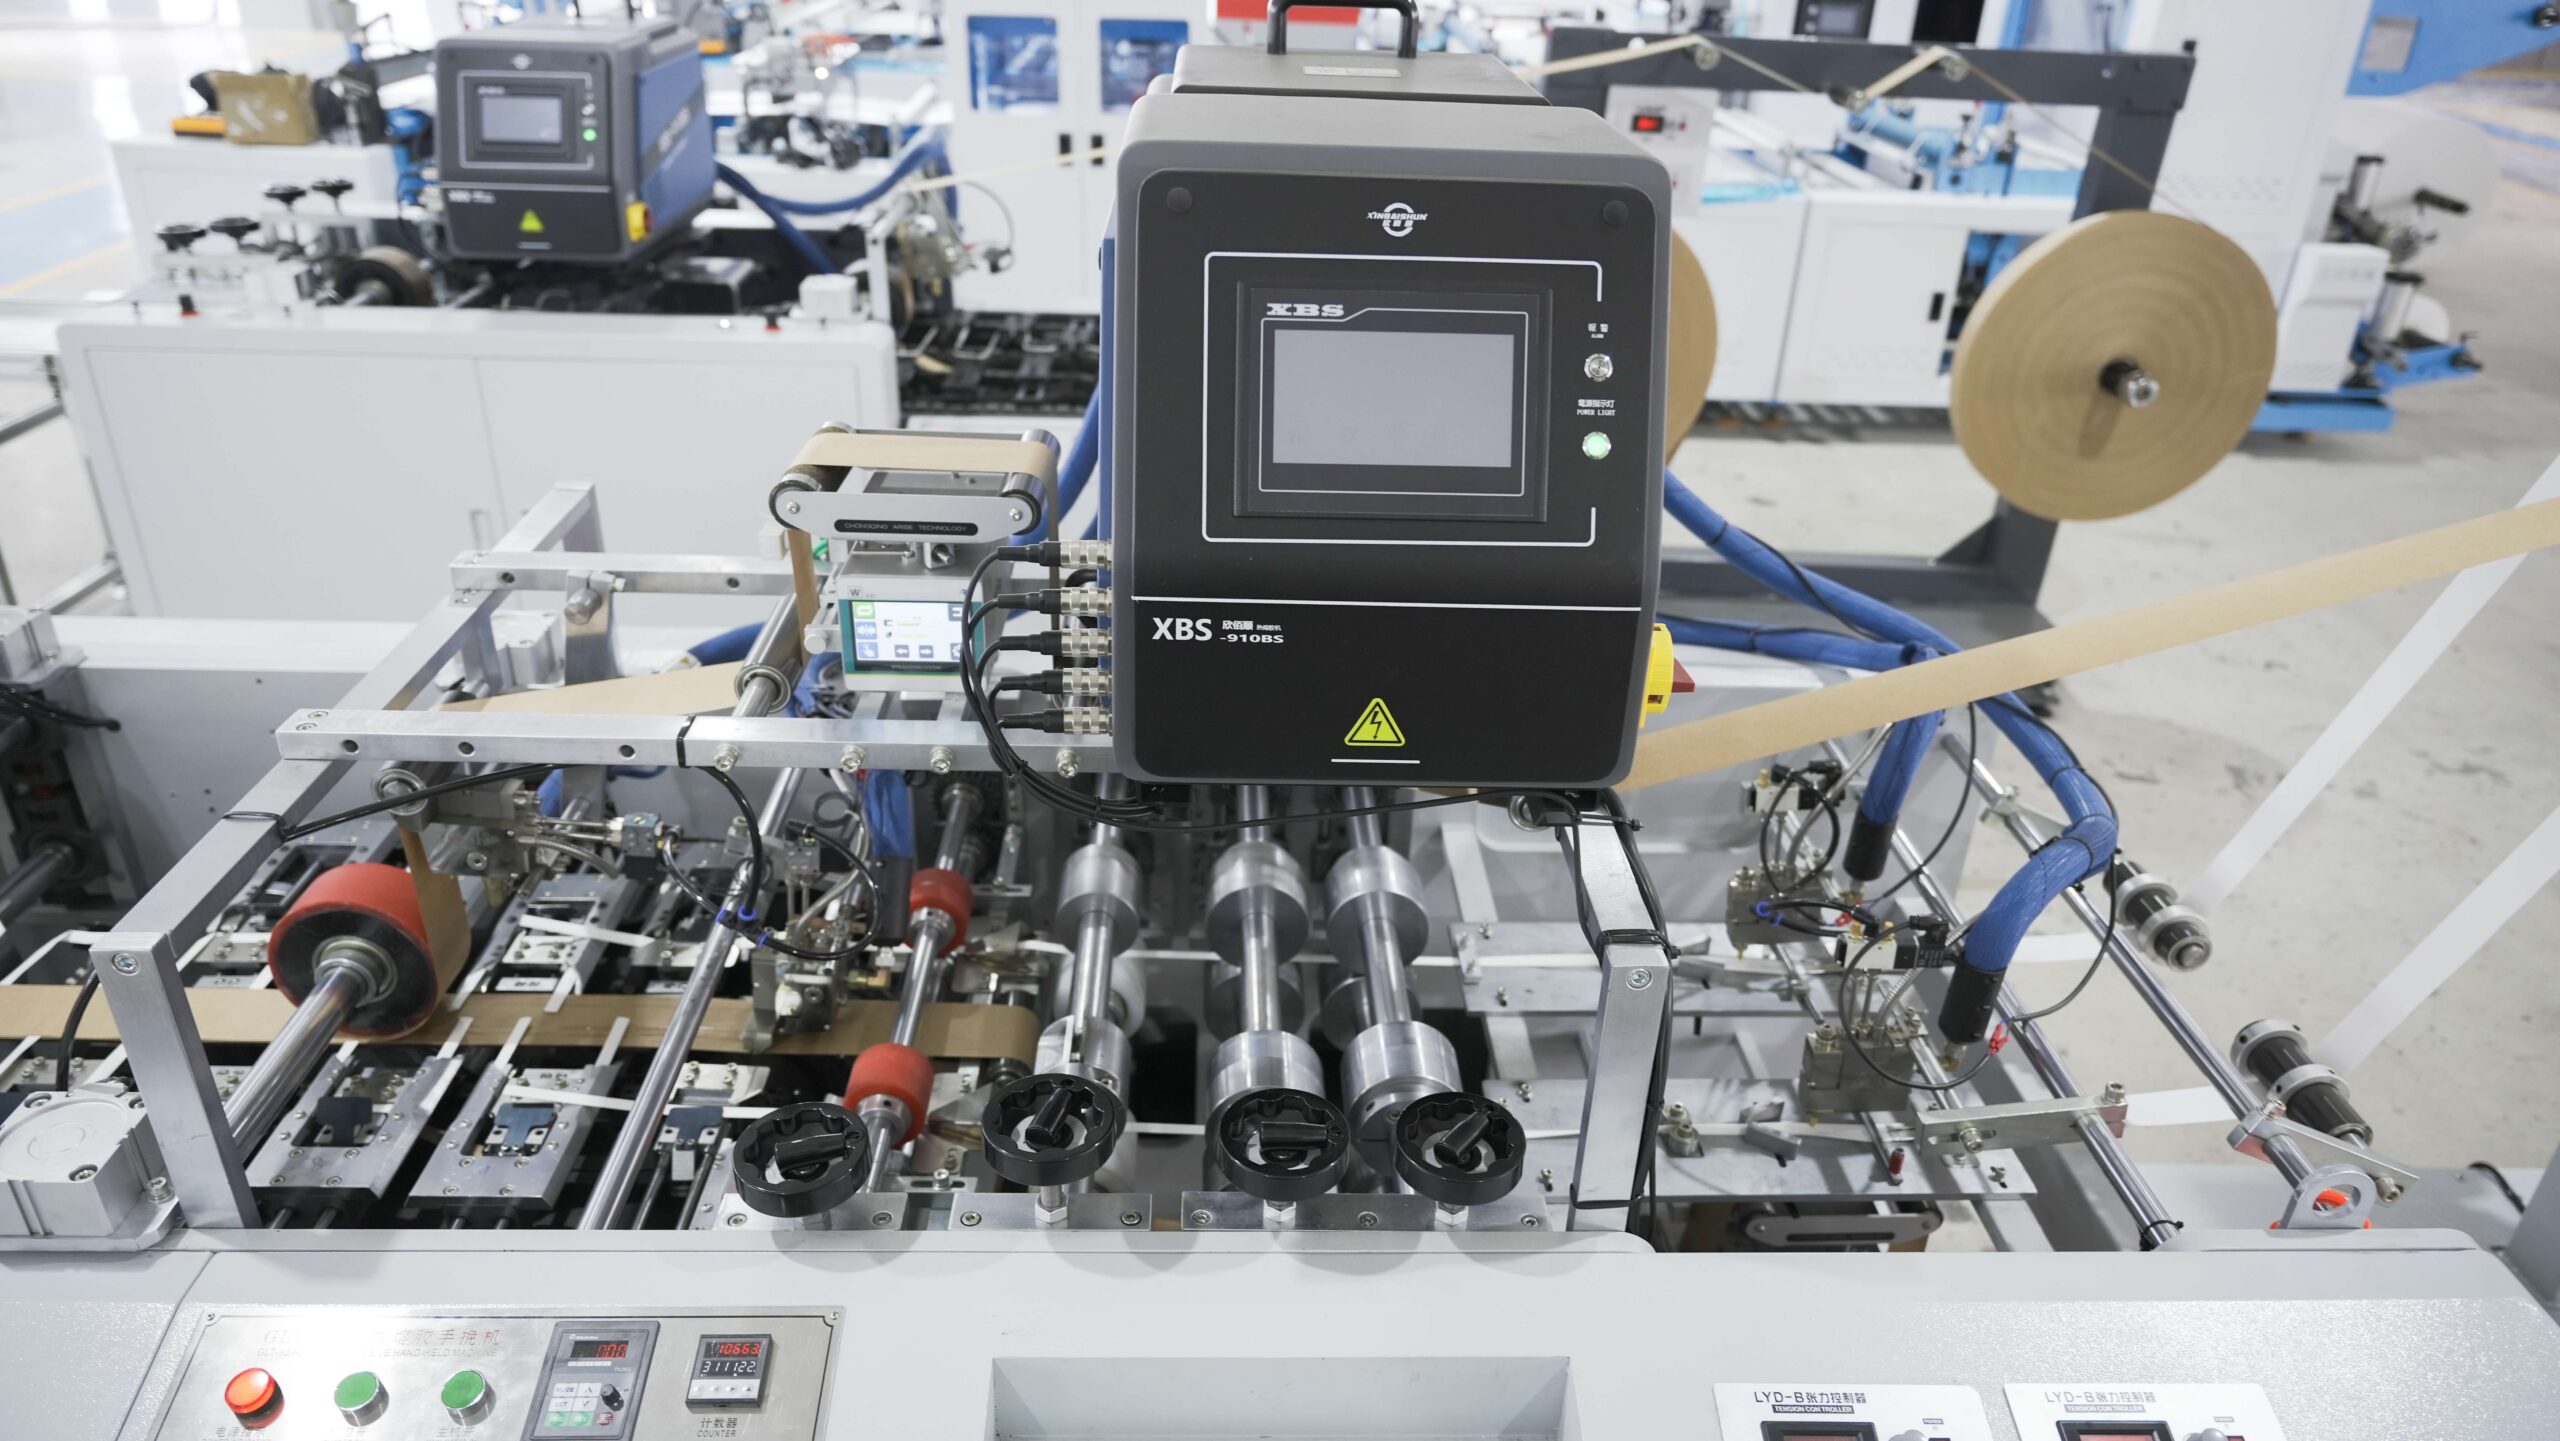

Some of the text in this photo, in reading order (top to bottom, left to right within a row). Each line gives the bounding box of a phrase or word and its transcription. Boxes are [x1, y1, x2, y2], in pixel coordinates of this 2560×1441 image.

[1366, 211, 1429, 221] XINBAISHUN
[1266, 303, 1344, 317] XBS
[844, 521, 968, 533] CHONGQING ARISE TECHNOLOGY
[1152, 617, 1213, 641] XBS
[1220, 633, 1285, 644] -910BS
[1775, 1405, 1805, 1413] TENSION
[700, 1418, 738, 1429] 计数器
[697, 1430, 737, 1438] COUNTER
